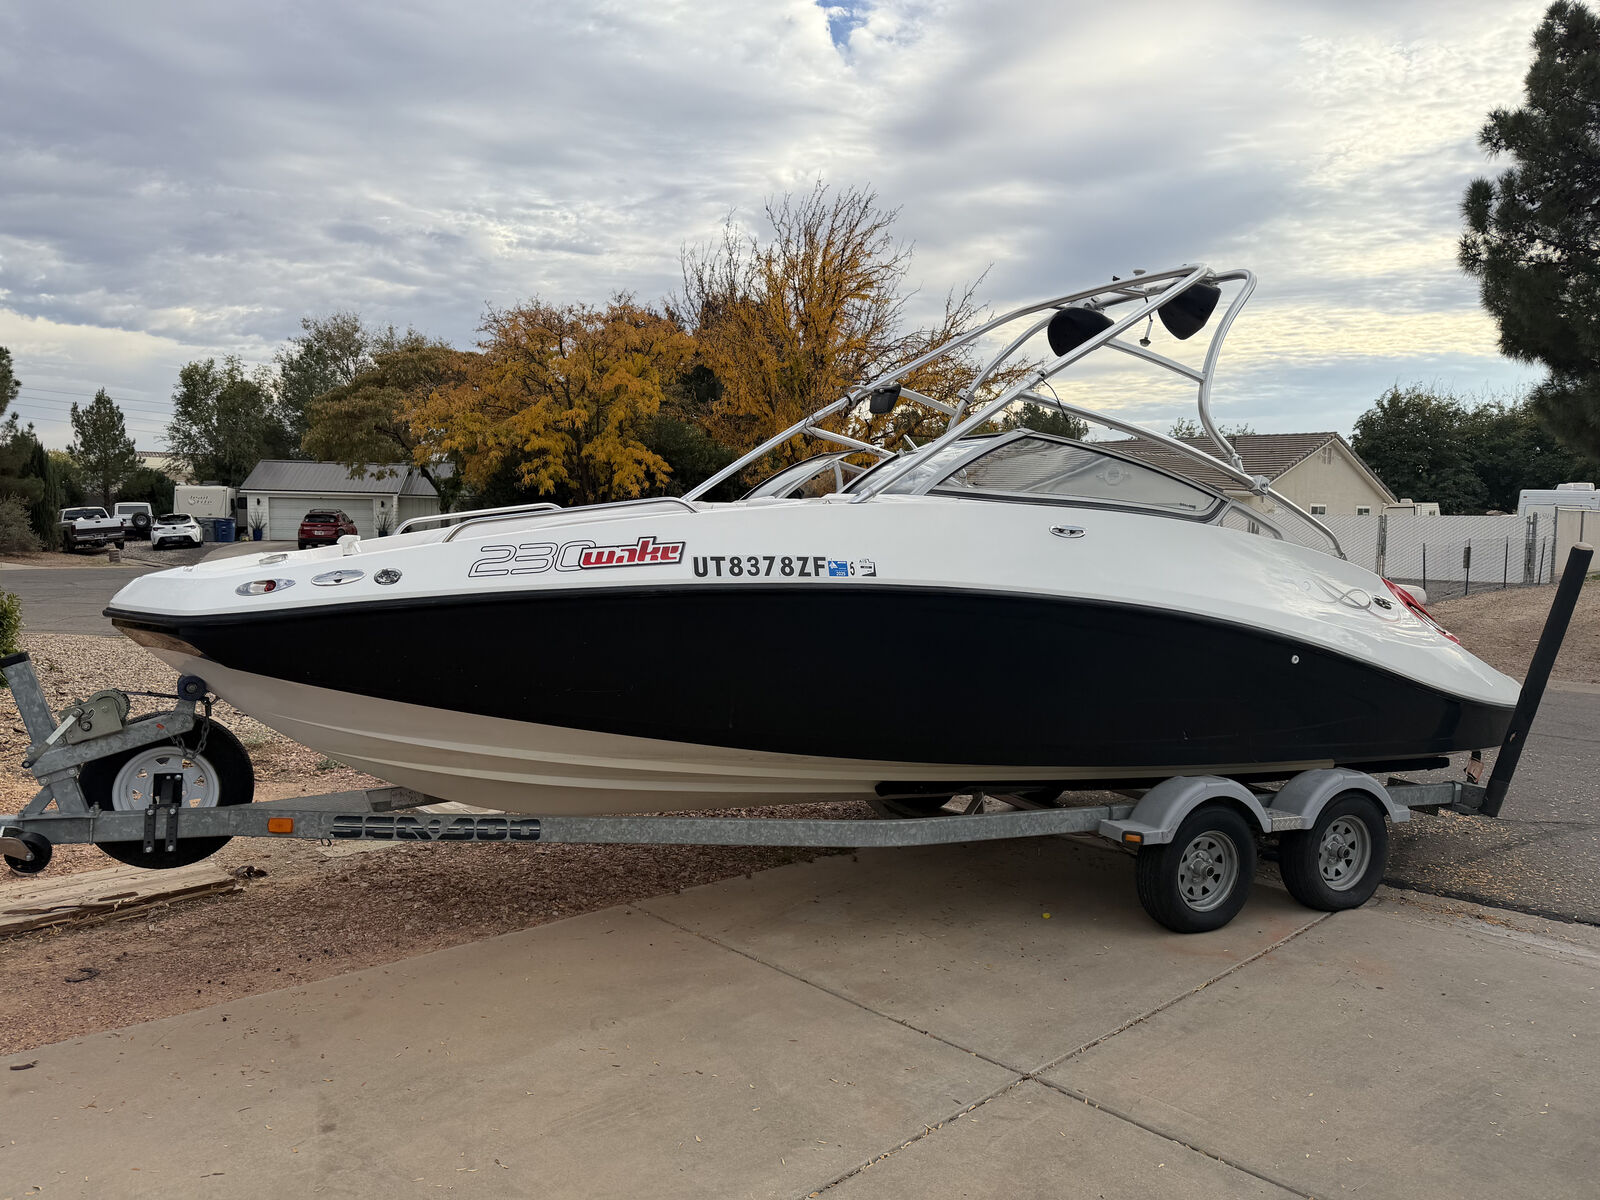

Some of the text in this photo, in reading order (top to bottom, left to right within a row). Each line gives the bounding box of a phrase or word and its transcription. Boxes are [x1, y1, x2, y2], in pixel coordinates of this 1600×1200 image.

[468, 537, 684, 577] 230 wake
[693, 556, 826, 577] UT8378ZF
